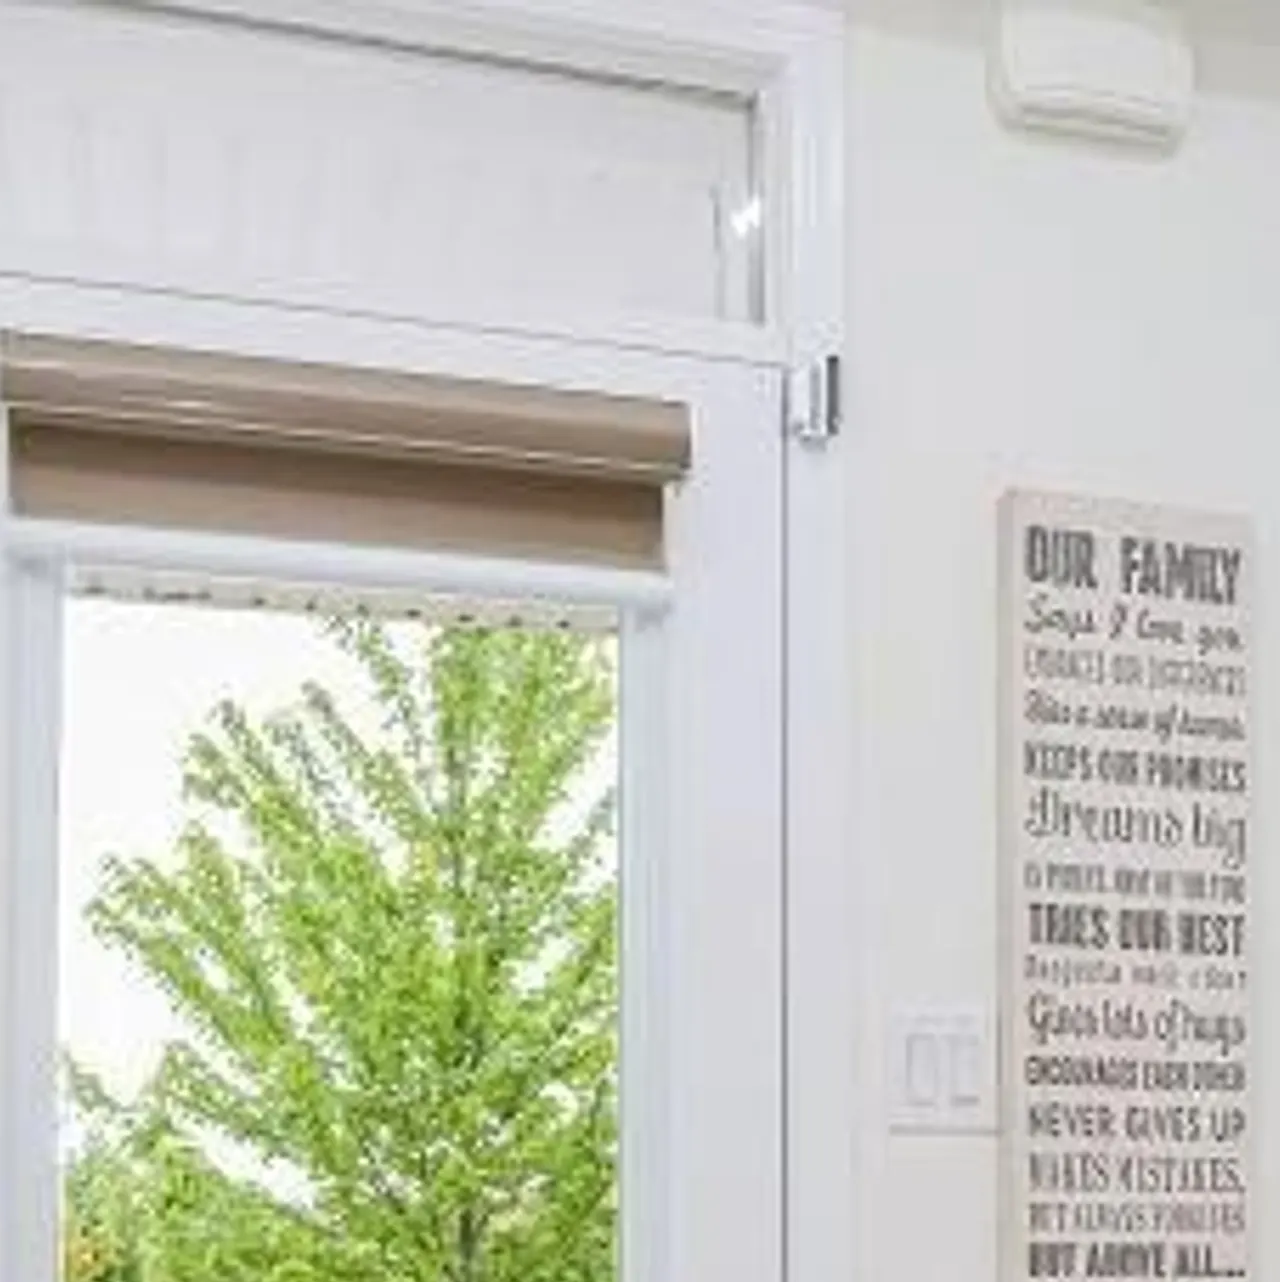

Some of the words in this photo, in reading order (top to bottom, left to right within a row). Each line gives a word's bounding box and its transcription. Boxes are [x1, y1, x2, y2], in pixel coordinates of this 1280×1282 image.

[1024, 524, 1097, 590] OUR
[1120, 537, 1241, 605] FAMILY
[1023, 787, 1183, 848] Dreams
[1192, 802, 1246, 870] big
[1029, 903, 1110, 950] TRIES
[1120, 909, 1169, 951] OUR
[1177, 912, 1246, 956] BEST
[1029, 1101, 1116, 1140] NEVER
[1125, 1104, 1200, 1142] GIVES
[1210, 1106, 1246, 1143] UP
[1029, 1242, 1075, 1278] BUT
[1086, 1242, 1166, 1278] ABOVE
